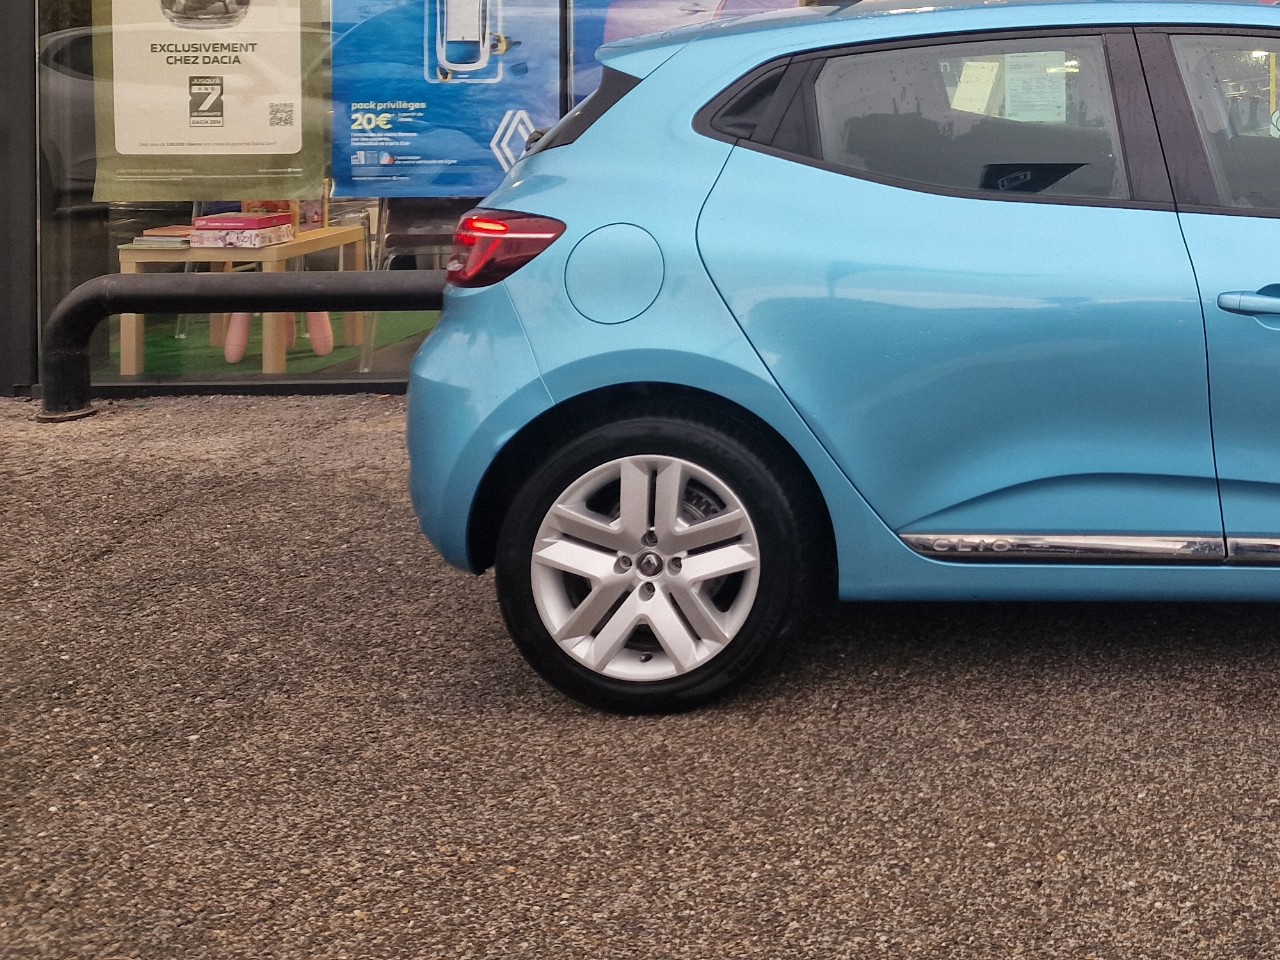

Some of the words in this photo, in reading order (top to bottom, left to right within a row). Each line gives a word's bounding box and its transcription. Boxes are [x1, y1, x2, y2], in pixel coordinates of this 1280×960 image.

[150, 43, 257, 53] EXCLUSIVEMENT
[166, 55, 199, 65] CHEZ
[202, 55, 241, 65] DACIA
[351, 101, 376, 110] pack
[377, 101, 427, 110] privilèges
[932, 539, 1010, 552] CLIO
